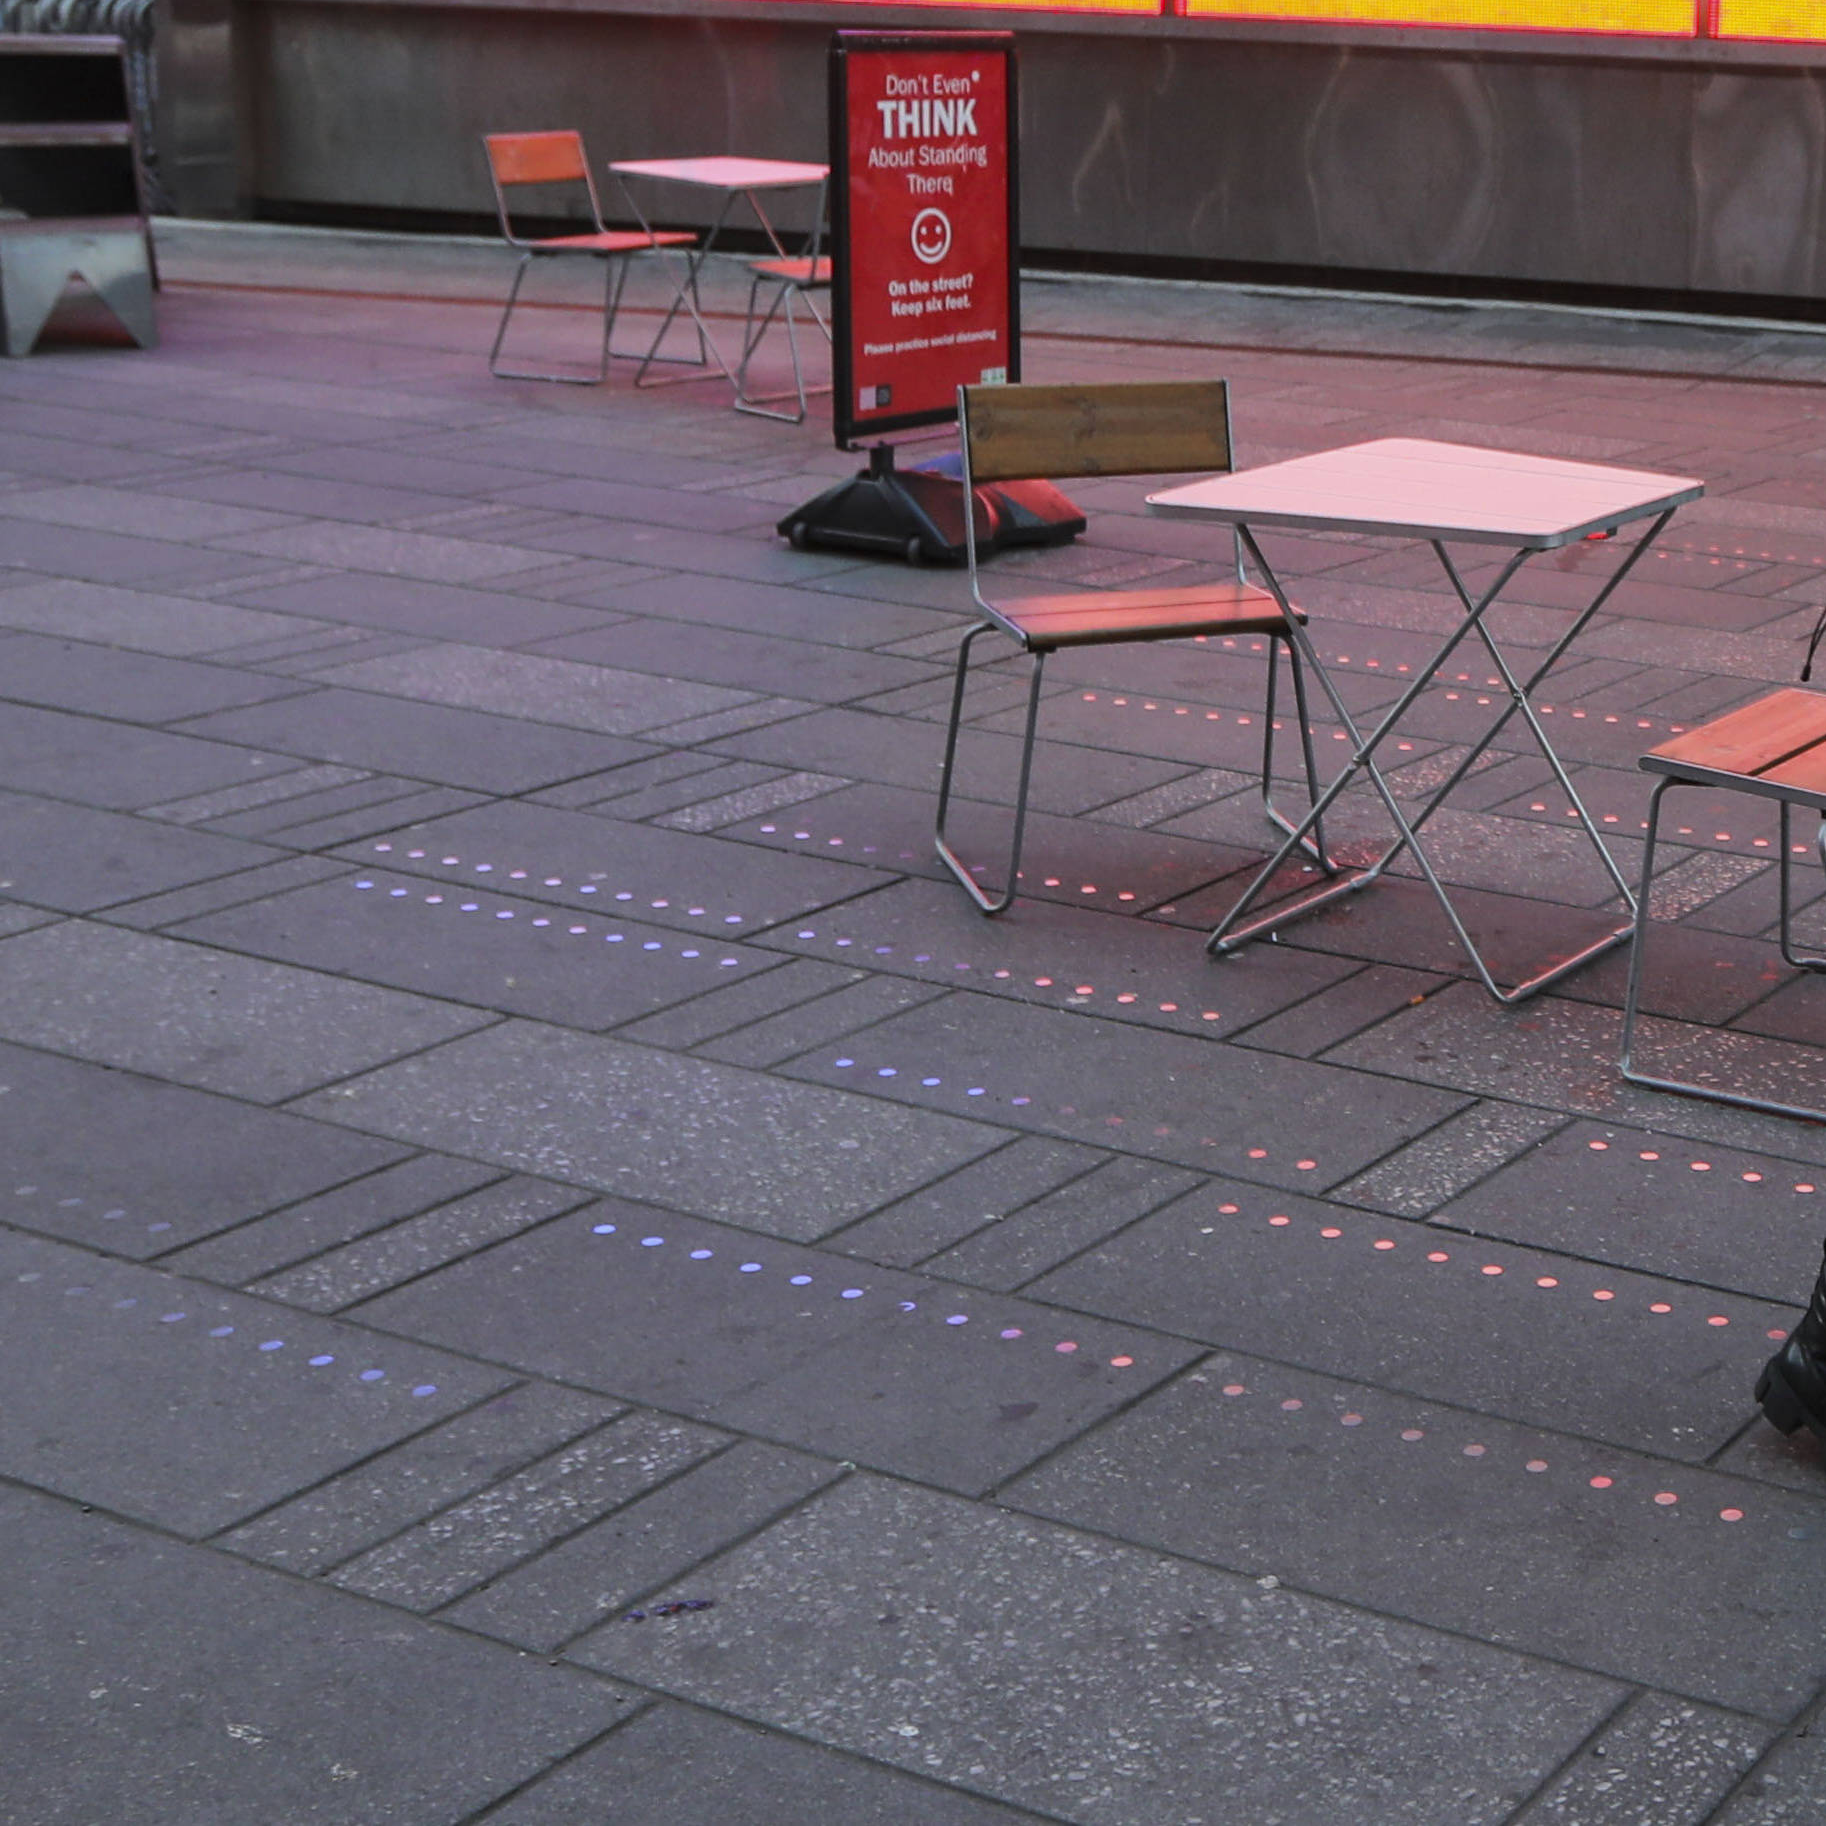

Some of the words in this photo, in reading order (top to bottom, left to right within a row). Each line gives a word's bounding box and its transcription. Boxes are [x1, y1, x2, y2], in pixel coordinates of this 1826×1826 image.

[886, 73, 929, 95] Don't
[933, 73, 971, 95] Even
[876, 98, 978, 139] THINK
[868, 147, 915, 169] About
[919, 143, 988, 167] Standing
[888, 279, 907, 297] On
[909, 277, 930, 295] the
[932, 272, 974, 292] street?
[891, 300, 923, 317] Keep
[925, 296, 943, 313] six
[945, 294, 972, 311] feet.
[864, 343, 894, 357] Please
[895, 338, 930, 354] practice
